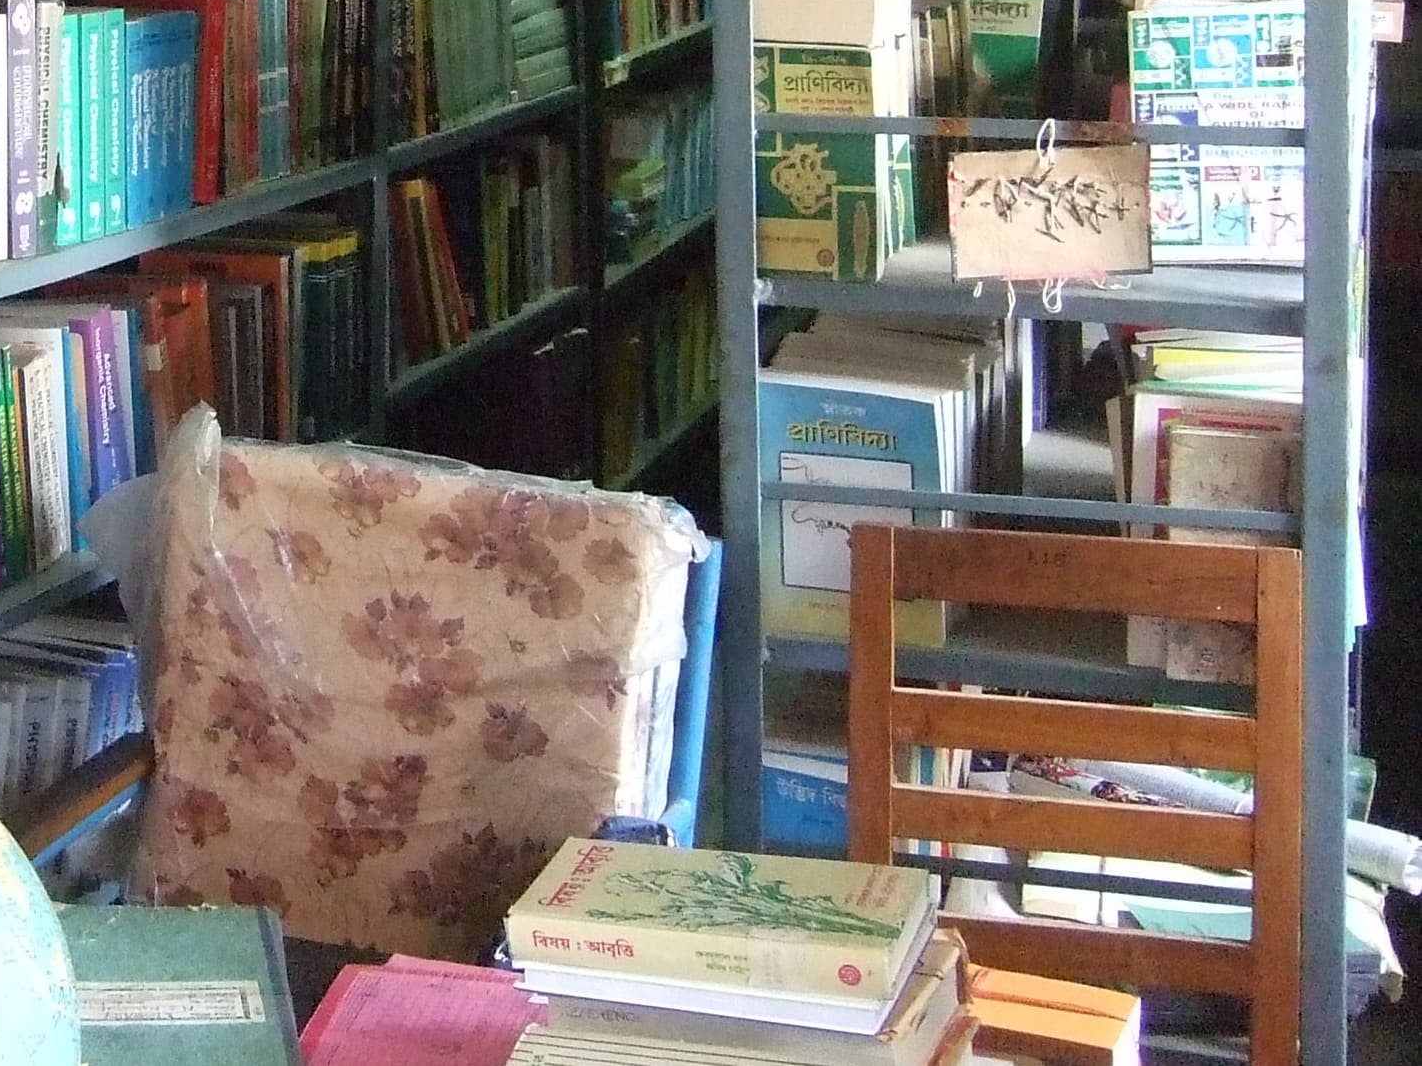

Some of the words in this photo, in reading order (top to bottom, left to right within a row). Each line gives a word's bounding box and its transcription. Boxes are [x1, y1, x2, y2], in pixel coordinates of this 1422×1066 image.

[88, 33, 99, 99] Physical
[109, 29, 120, 95] Physical
[784, 69, 869, 95] প্রাণিবিদ্যা
[40, 100, 50, 180] CHEMISTRY
[88, 103, 100, 182] Chemistry
[109, 98, 121, 176] Chemistry
[94, 327, 105, 384] Inorganic
[104, 352, 117, 411] Advanced
[9, 405, 19, 472] SEPARATION
[98, 384, 111, 445] Chemistry
[532, 929, 571, 951] বিষয়
[584, 938, 635, 959] আবৃত্তি
